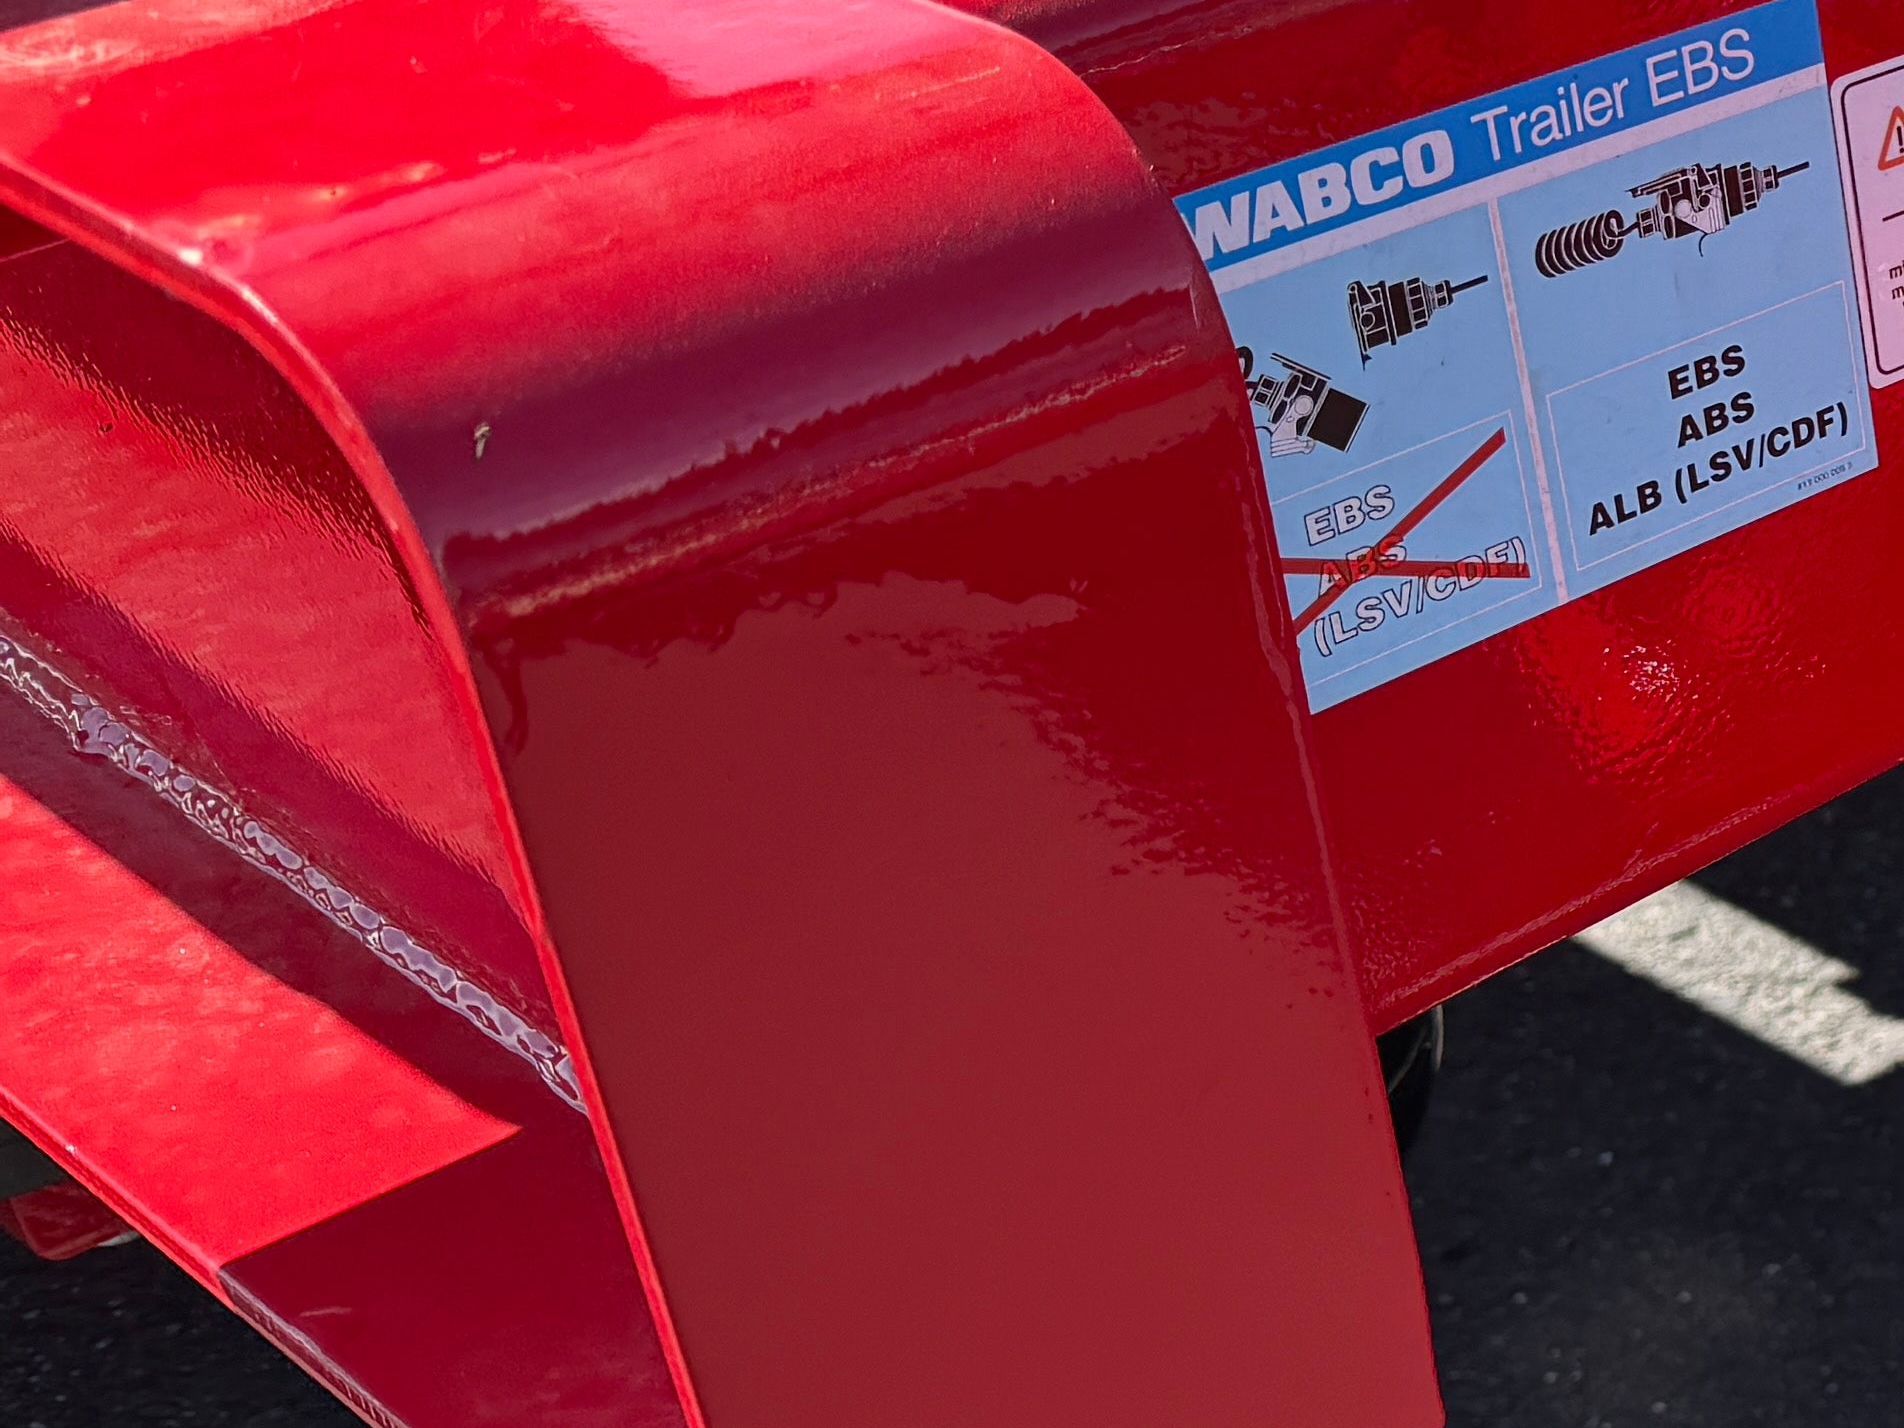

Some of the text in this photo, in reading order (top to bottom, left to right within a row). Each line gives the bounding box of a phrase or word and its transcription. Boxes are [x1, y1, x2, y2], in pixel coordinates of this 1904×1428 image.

[1470, 77, 1629, 161] Trailer
[1646, 28, 1755, 107] EBS
[1668, 345, 1745, 399] EBS
[1677, 391, 1754, 448] ABS
[1589, 401, 1848, 536] ALB (LSV/CDF)
[1304, 484, 1395, 546] EBS
[1314, 536, 1526, 658] (LSV/CDF)
[1318, 534, 1407, 598] ABS
